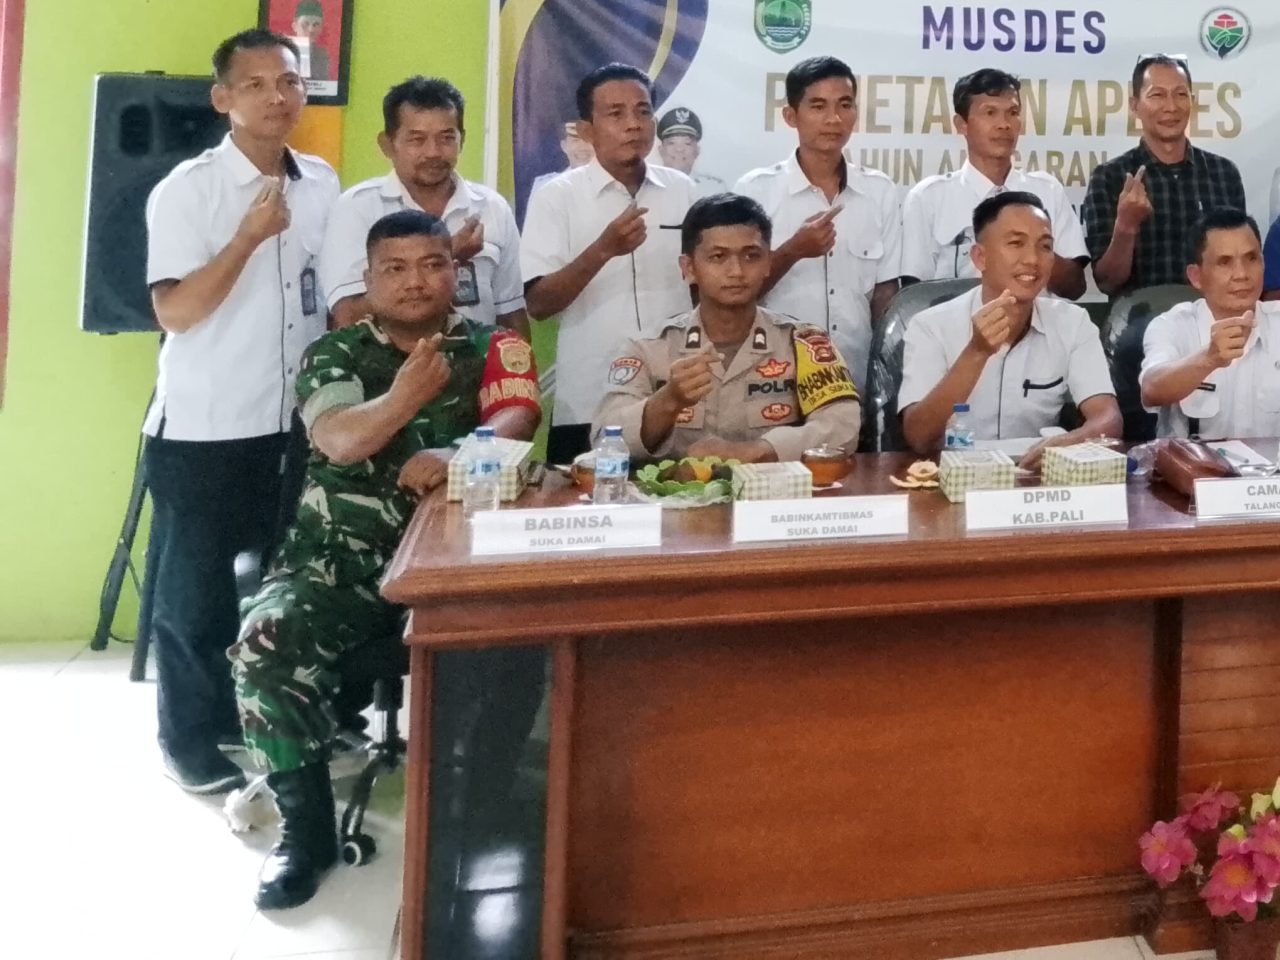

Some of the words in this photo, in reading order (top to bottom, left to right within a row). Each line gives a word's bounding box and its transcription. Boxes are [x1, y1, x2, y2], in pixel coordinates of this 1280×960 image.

[922, 5, 1106, 54] MUSDES
[764, 72, 1048, 136] PETAN
[1063, 79, 1242, 138] APES
[748, 379, 795, 396] POLR
[1023, 490, 1071, 504] DPMD
[524, 515, 613, 531] BABINSA
[771, 510, 873, 523] BABINKAMTIBMAS
[1012, 510, 1084, 525] KAB.PALI
[787, 527, 819, 536] SUKA
[822, 525, 858, 534] DAMAI
[529, 537, 563, 547] SUKA
[567, 535, 606, 545] DAMAI
